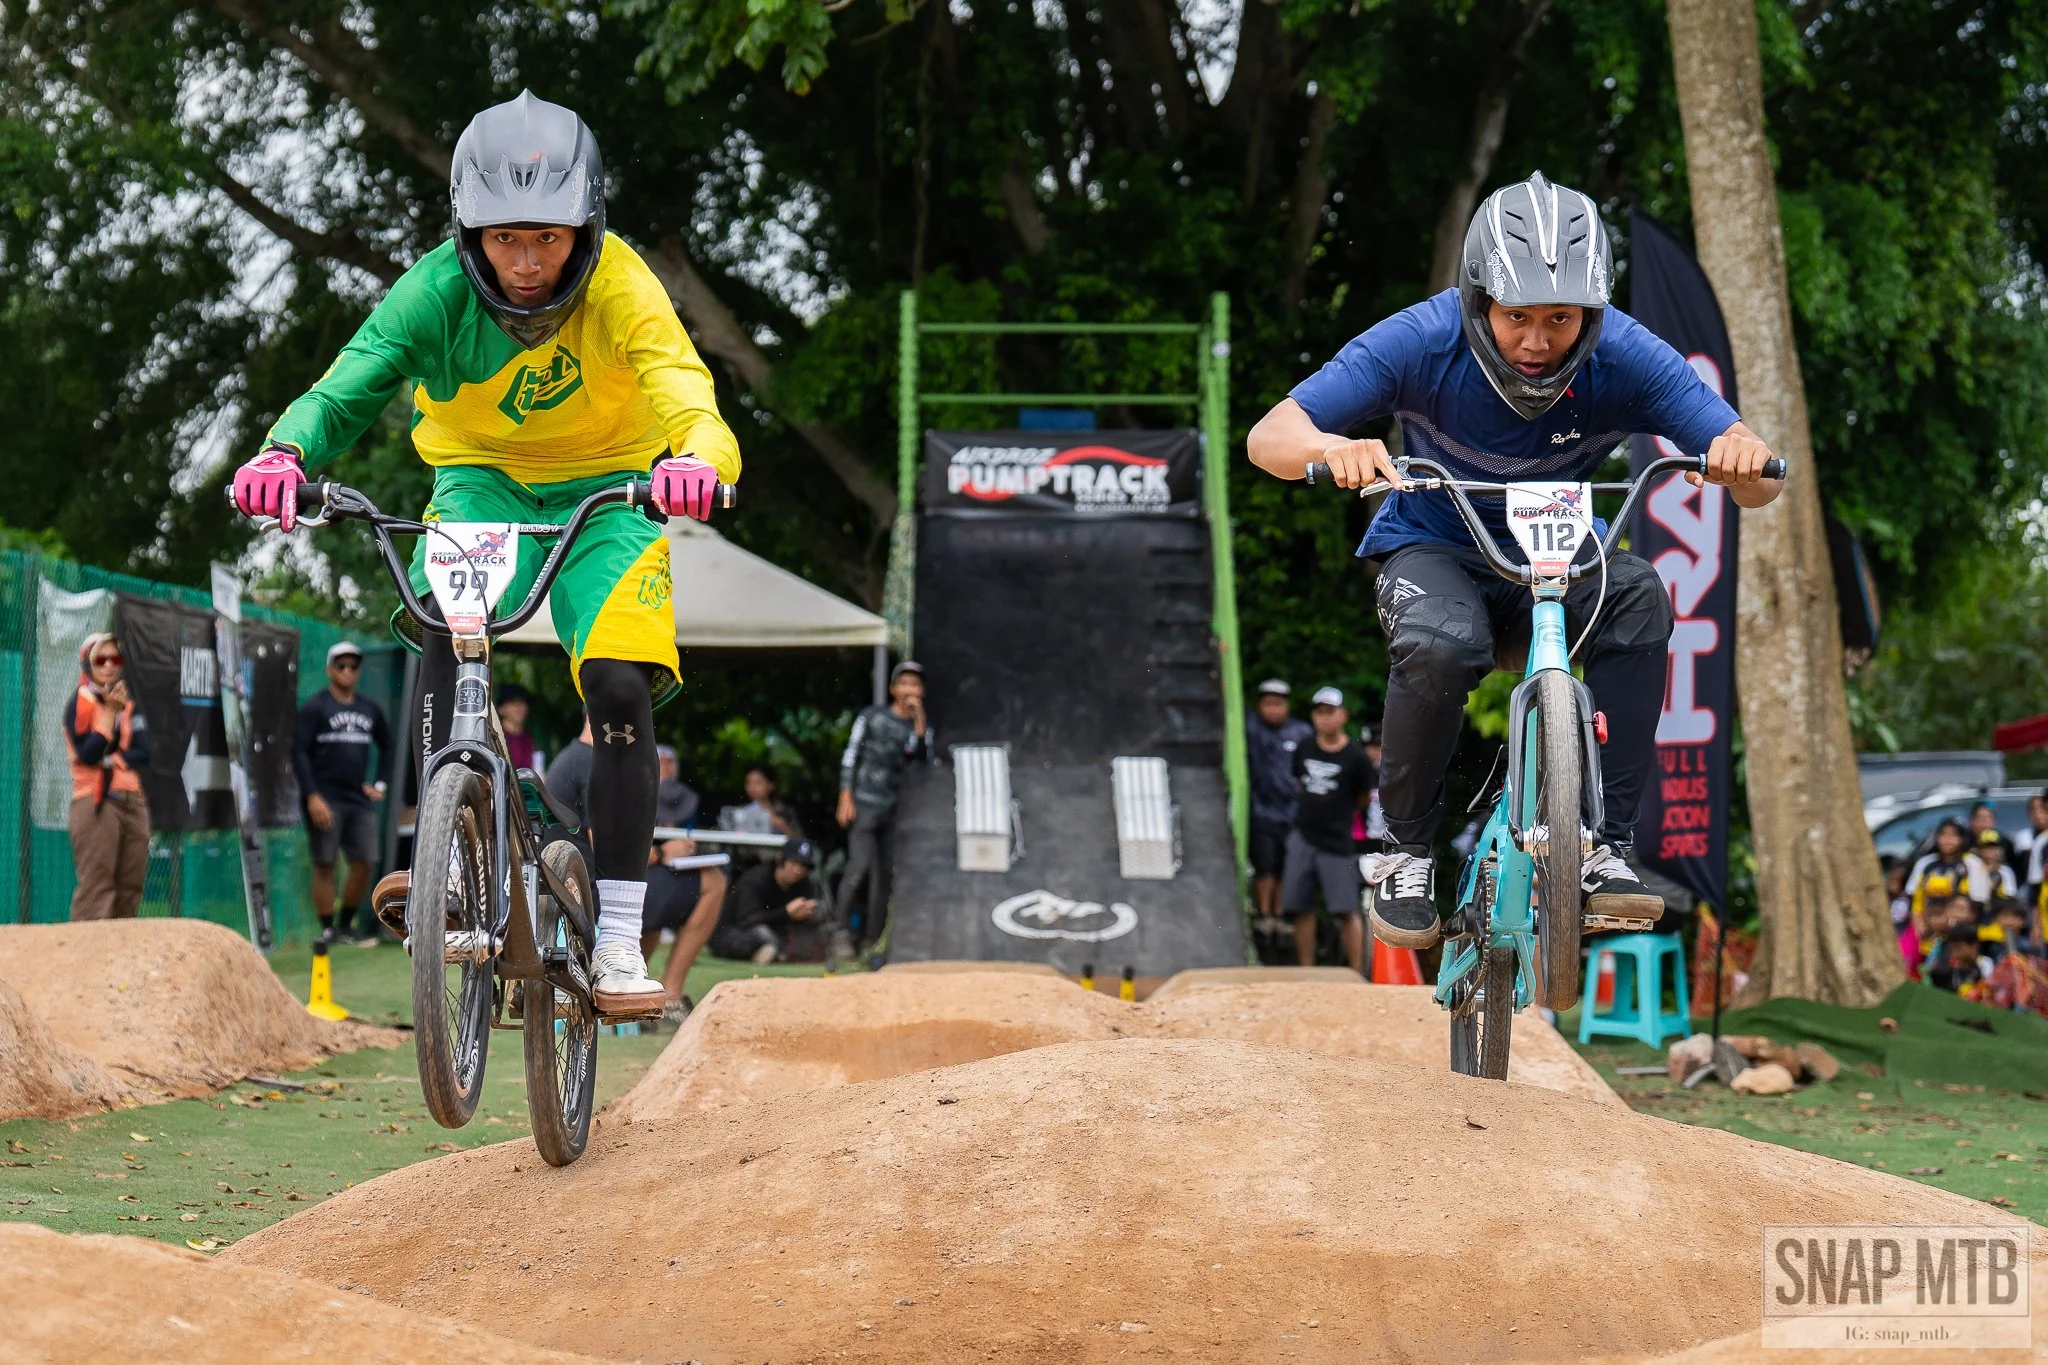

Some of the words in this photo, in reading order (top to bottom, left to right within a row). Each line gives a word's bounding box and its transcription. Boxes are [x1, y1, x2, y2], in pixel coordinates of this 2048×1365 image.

[948, 464, 1169, 494] PUMPTRACK
[1529, 523, 1575, 551] 112
[449, 571, 489, 601] 99
